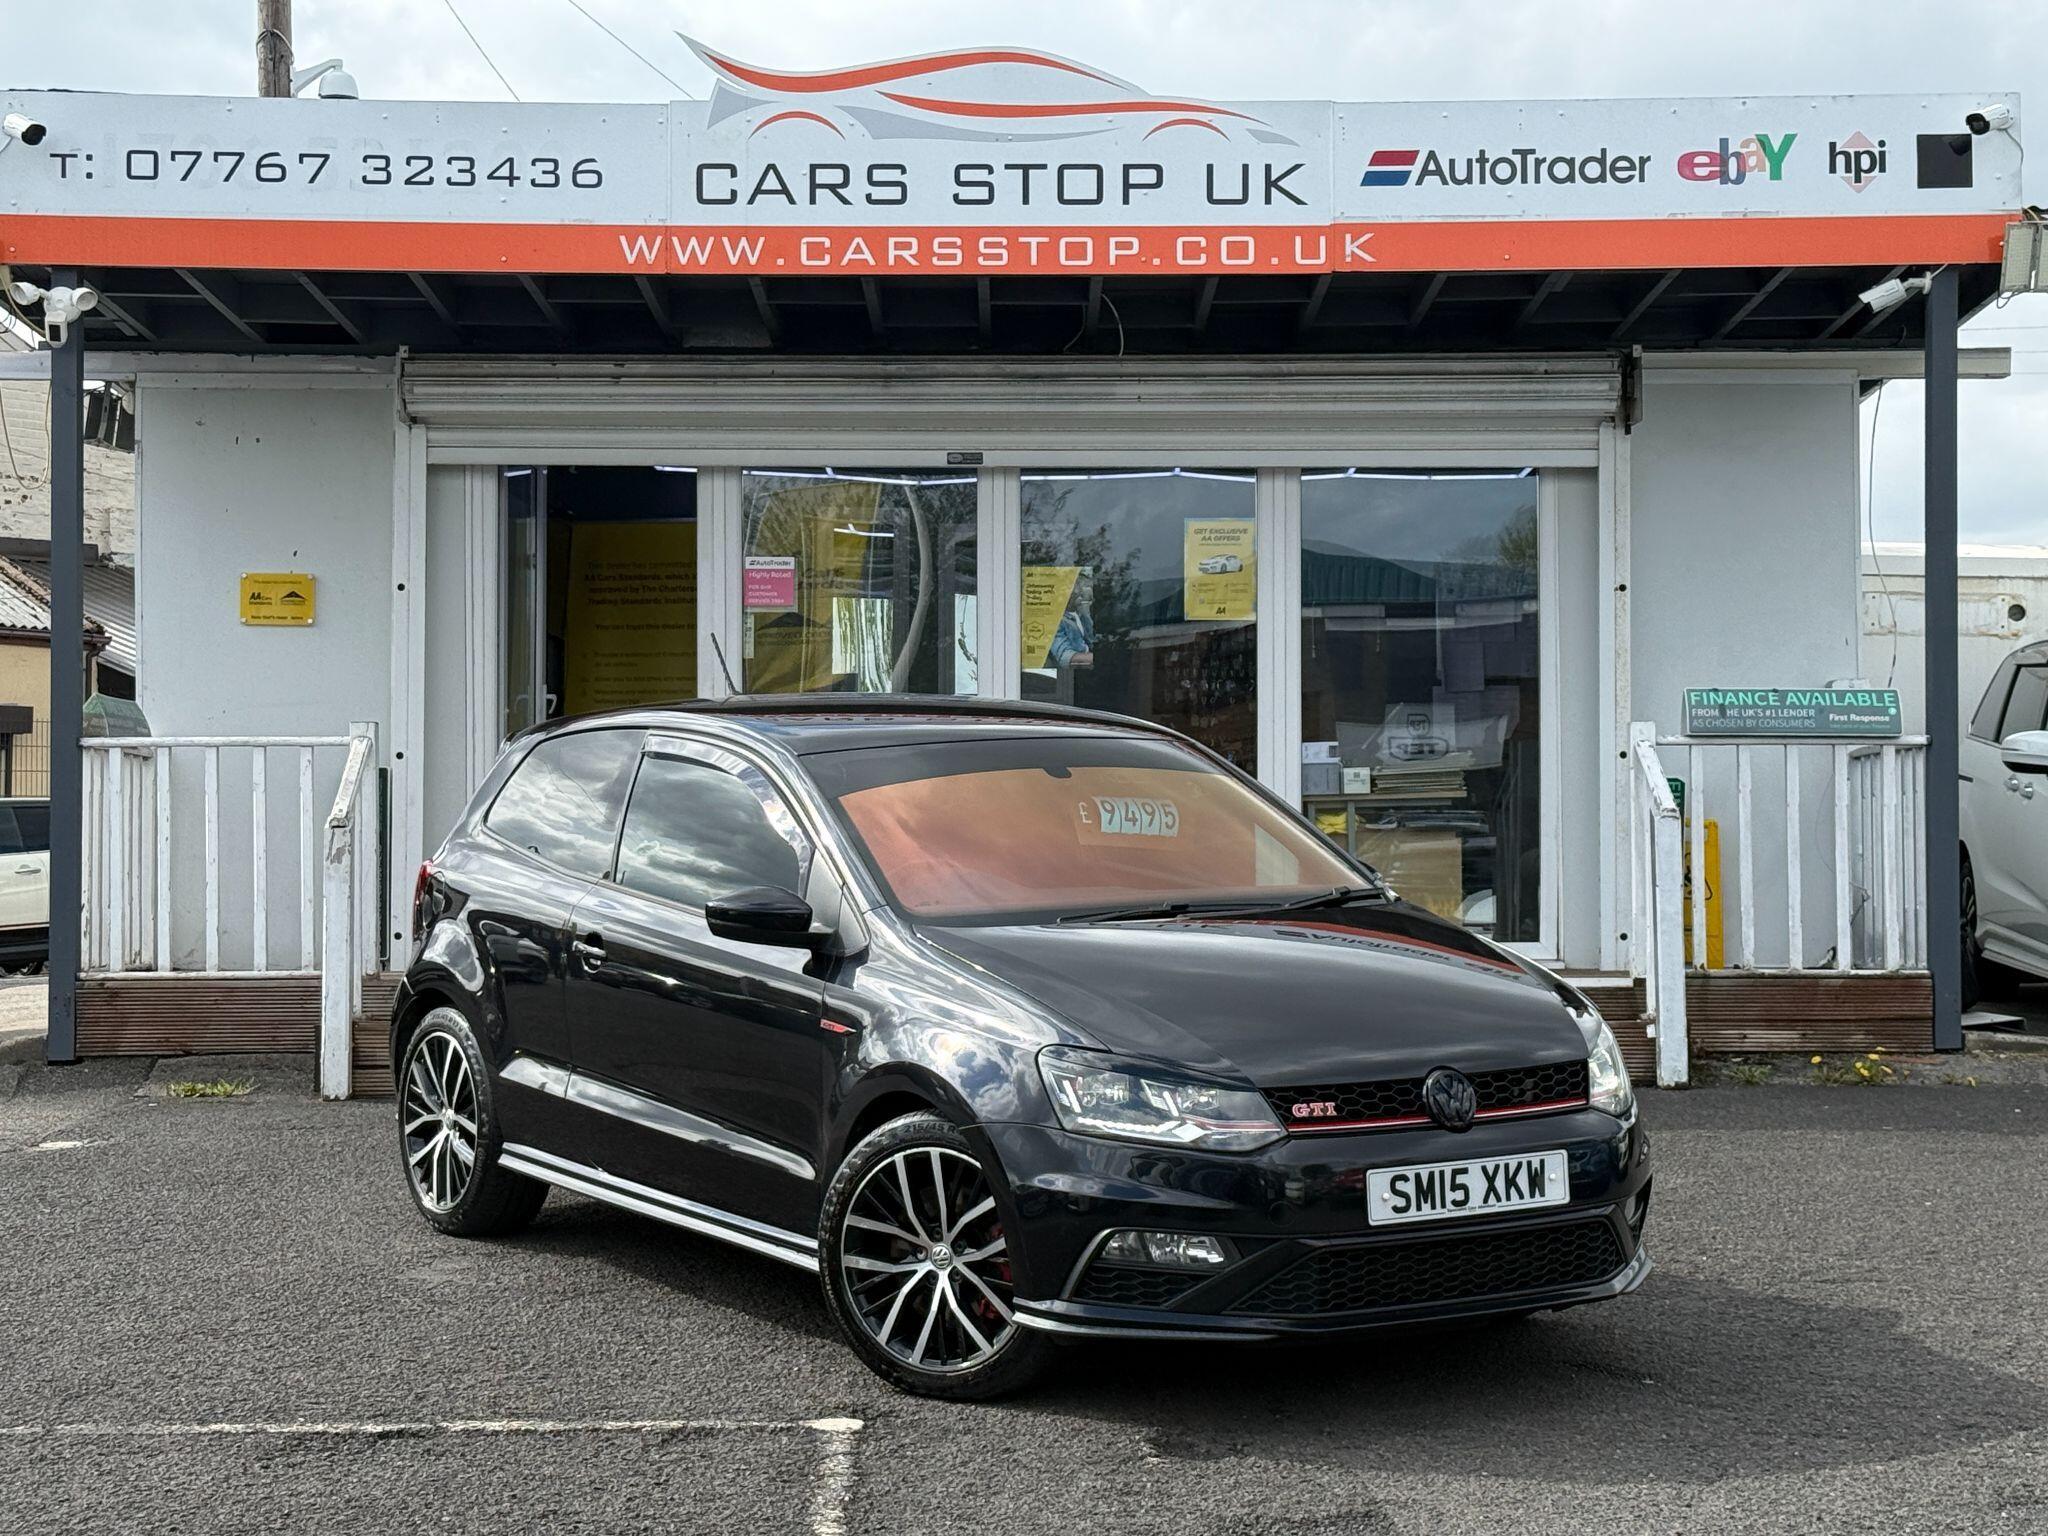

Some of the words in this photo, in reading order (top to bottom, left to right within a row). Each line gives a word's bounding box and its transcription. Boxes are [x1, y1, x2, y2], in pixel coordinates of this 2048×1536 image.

[49, 153, 93, 180] T:
[126, 149, 331, 184] 07767
[361, 154, 604, 189] 323436
[1415, 147, 1652, 186] AutoTrader
[1828, 139, 1887, 185] hpi
[696, 163, 908, 206] CARS
[952, 163, 1165, 206] STOP
[1206, 163, 1308, 206] UK
[619, 232, 1378, 268] WWW.CARSSTOP.CO.UK
[1690, 691, 1780, 706] FINANCE
[1786, 691, 1897, 707] AVAILABLE
[1692, 707, 1720, 717] FROM
[1742, 707, 1764, 717] UK'S
[1765, 708, 1777, 717] #1
[1779, 708, 1815, 718] LENDER
[1692, 719, 1704, 728] AS
[1706, 719, 1743, 728] CHOSEN
[1746, 719, 1757, 728] BY
[1760, 719, 1816, 728] CONSUMERS
[1829, 713, 1848, 722] First
[1850, 713, 1890, 724] Response
[1291, 1101, 1338, 1118] GTI
[1389, 1167, 1470, 1215] SM15
[1480, 1157, 1547, 1204] XKW
